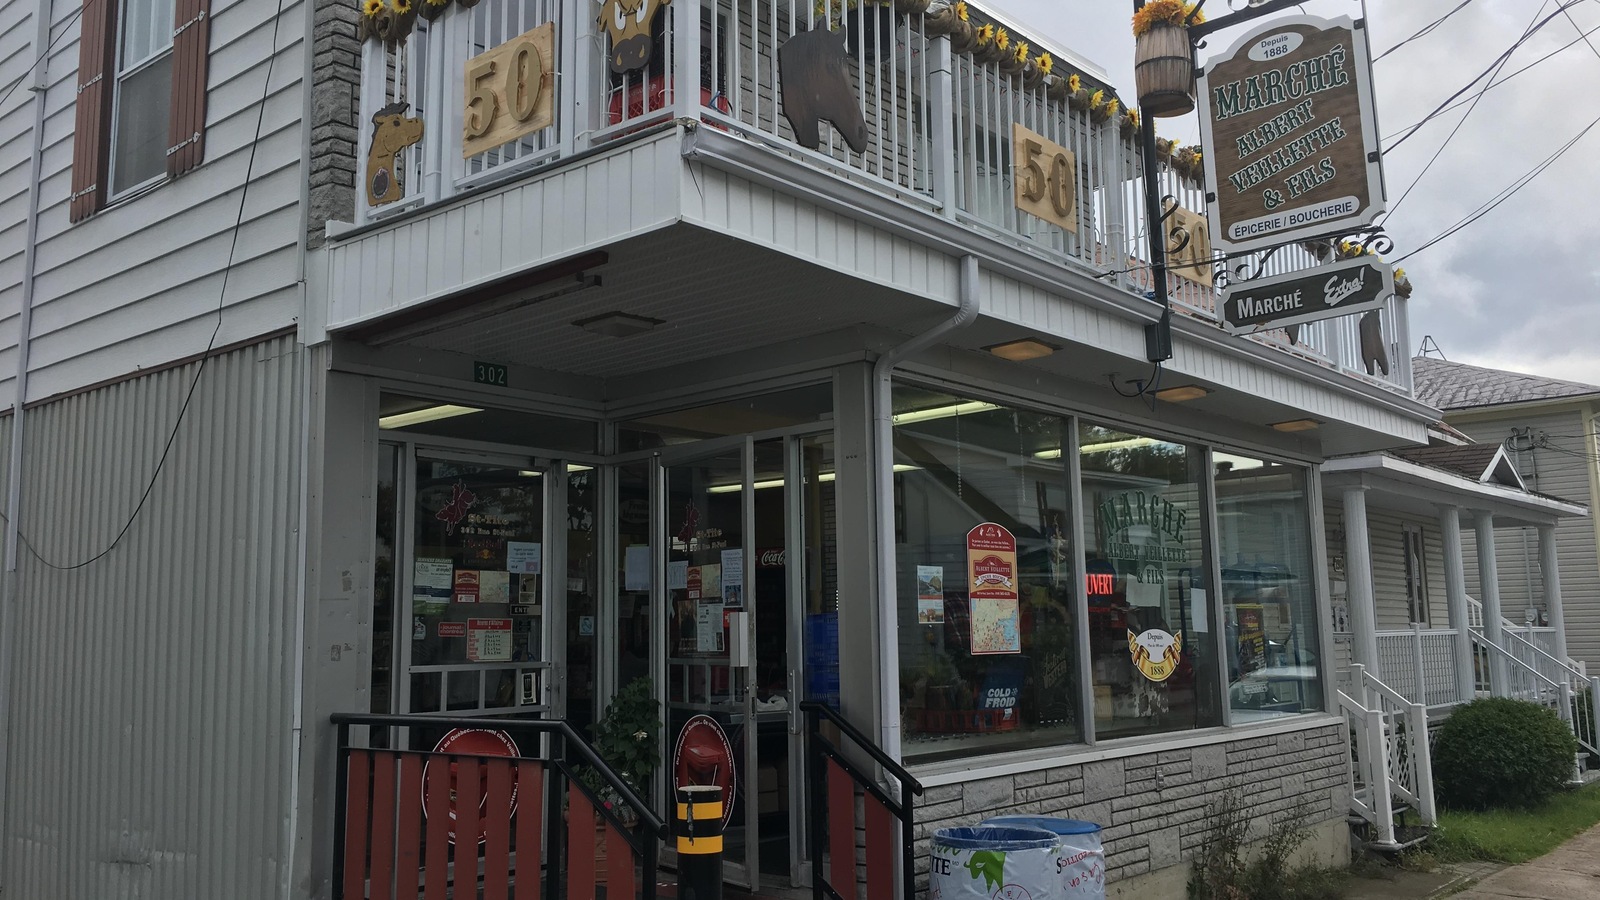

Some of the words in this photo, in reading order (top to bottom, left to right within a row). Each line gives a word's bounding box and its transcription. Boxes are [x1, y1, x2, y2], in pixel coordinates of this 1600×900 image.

[1261, 34, 1289, 49] Depuis
[1263, 44, 1288, 60] 1888
[465, 41, 543, 141] 50
[1213, 43, 1350, 121] MARCHÉ
[1235, 98, 1316, 160] ALBERT
[1228, 117, 1348, 194] VEILLETTE
[1022, 137, 1075, 218] 50
[1262, 188, 1285, 211] &
[1285, 156, 1337, 200] FILS
[1234, 215, 1282, 239] ÉPICERIE
[1288, 201, 1353, 227] BOUCHERIE
[1171, 212, 1211, 277] 50
[1323, 267, 1365, 306] Extra!
[478, 365, 505, 384] 302
[1100, 489, 1187, 545] MARCHÉ
[1108, 544, 1140, 560] ALBERT
[1144, 545, 1187, 563] VEILLETTE
[1085, 573, 1113, 595] UVERT
[1136, 571, 1145, 583] &
[1146, 569, 1165, 584] FILS
[1147, 632, 1164, 642] Depuis
[1150, 665, 1165, 676] 1888
[985, 697, 1016, 708] FROID
[987, 688, 1011, 698] COLD
